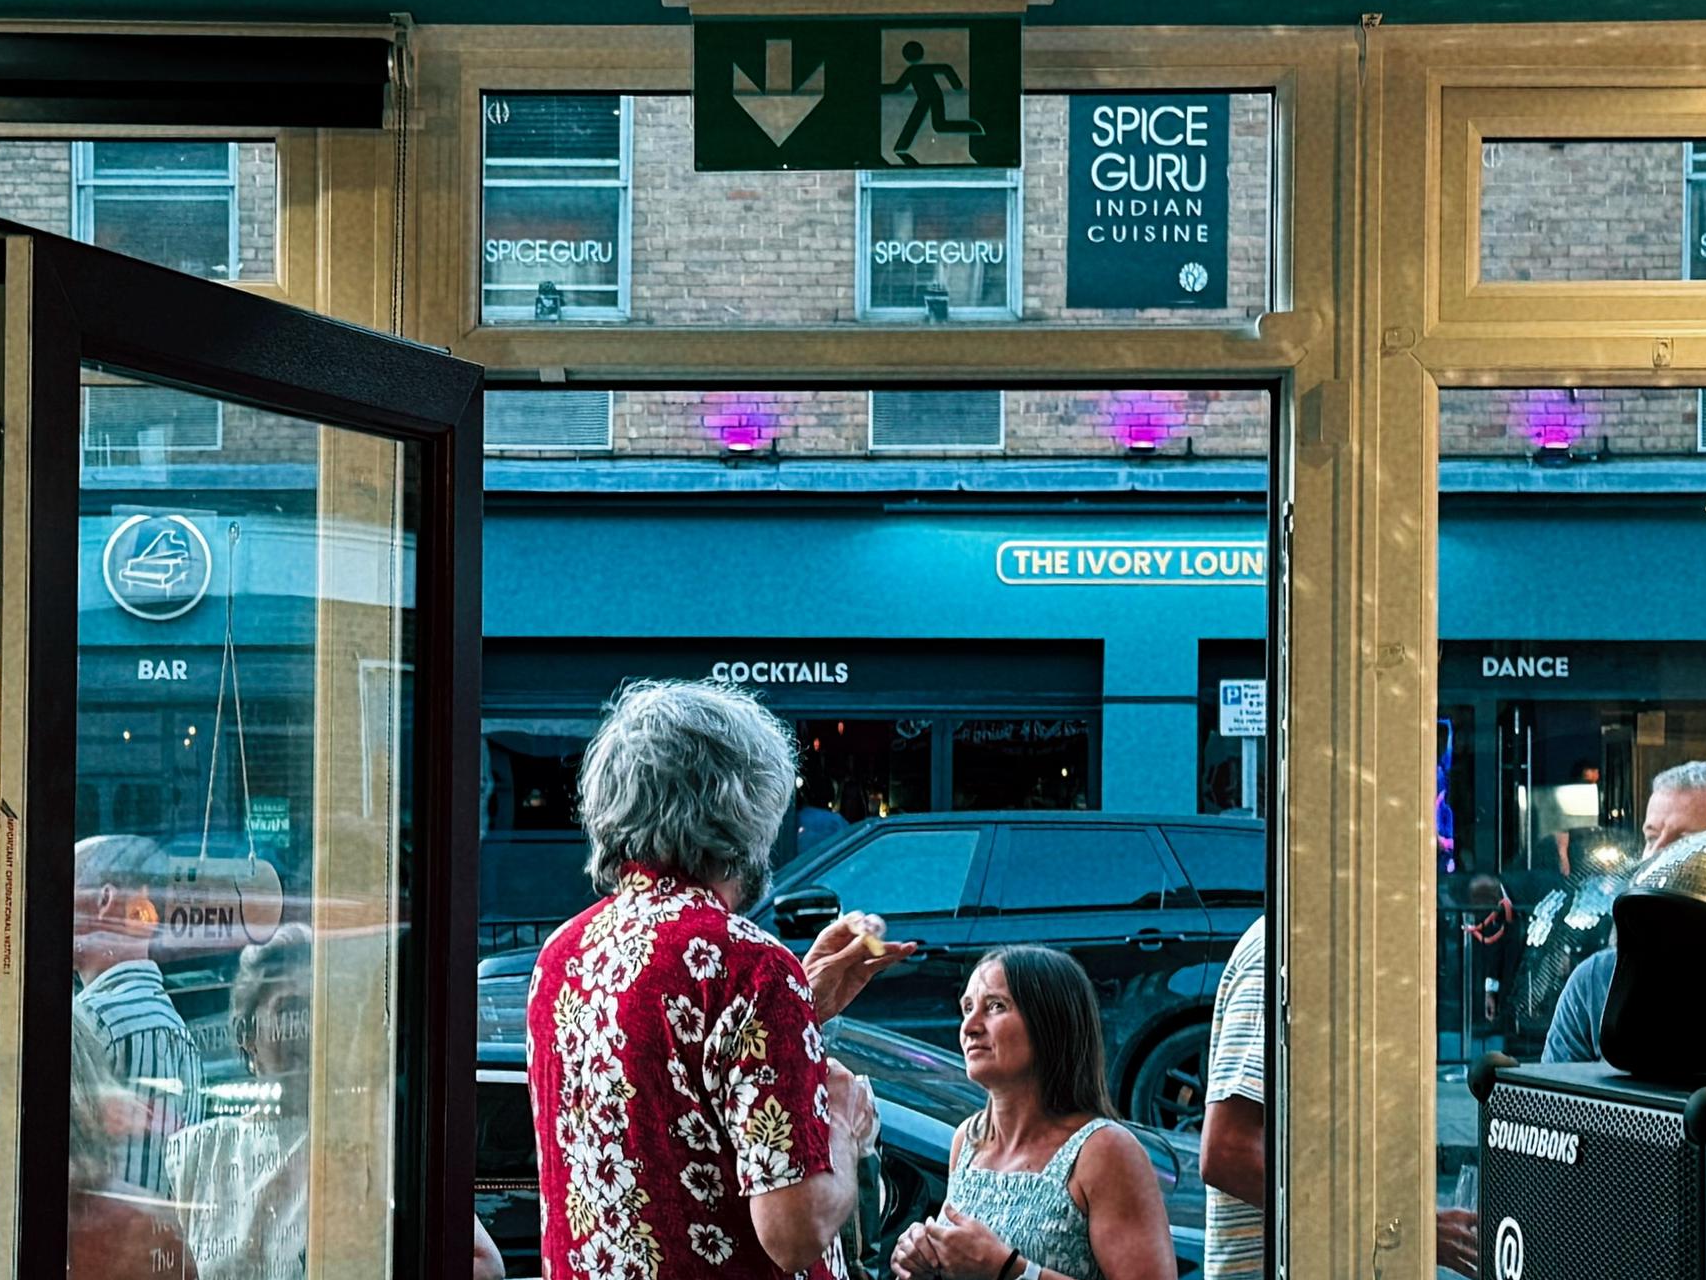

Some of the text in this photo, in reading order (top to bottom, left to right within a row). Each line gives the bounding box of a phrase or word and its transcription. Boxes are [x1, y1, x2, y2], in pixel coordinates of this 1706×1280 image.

[1092, 106, 1208, 147] SPICE
[1091, 152, 1207, 192] GURU
[1096, 199, 1202, 216] INDIAN
[1087, 224, 1208, 242] CUISINE
[485, 239, 612, 262] SPICE GURU
[875, 241, 1003, 264] SPICE GURU
[1013, 550, 1263, 575] THE IVORY LOUN
[138, 660, 187, 680] BAR
[712, 662, 848, 684] COCKTAILS
[1483, 657, 1569, 677] DANCE
[170, 906, 233, 938] OPEN
[1489, 1118, 1579, 1165] SOUNDBOKS
